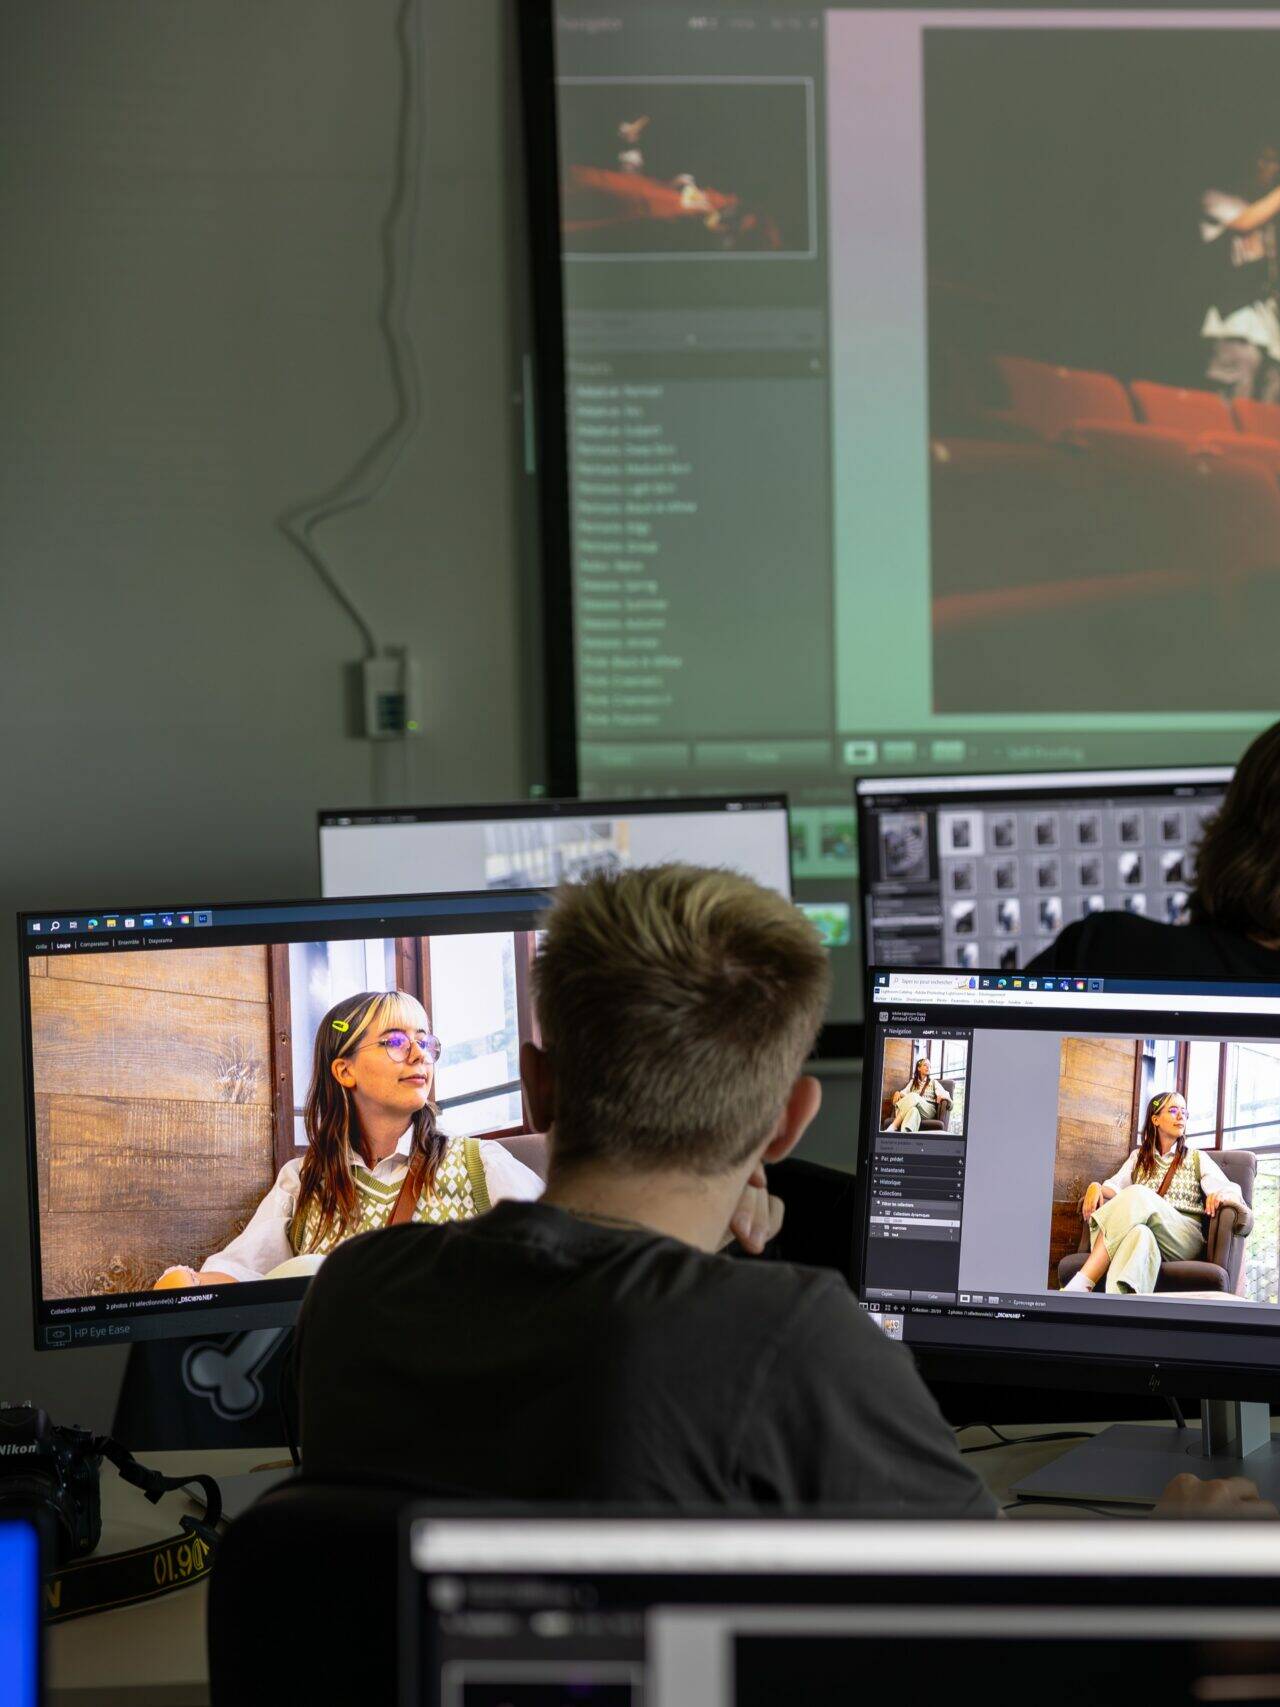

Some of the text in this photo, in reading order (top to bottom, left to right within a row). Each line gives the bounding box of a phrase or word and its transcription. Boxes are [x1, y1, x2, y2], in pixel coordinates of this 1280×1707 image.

[888, 1028, 912, 1036] Navigation
[50, 1307, 76, 1315] Collection
[110, 1302, 128, 1310] photos
[74, 1324, 130, 1339] HP Eye Ease
[0, 1443, 38, 1456] Nikon
